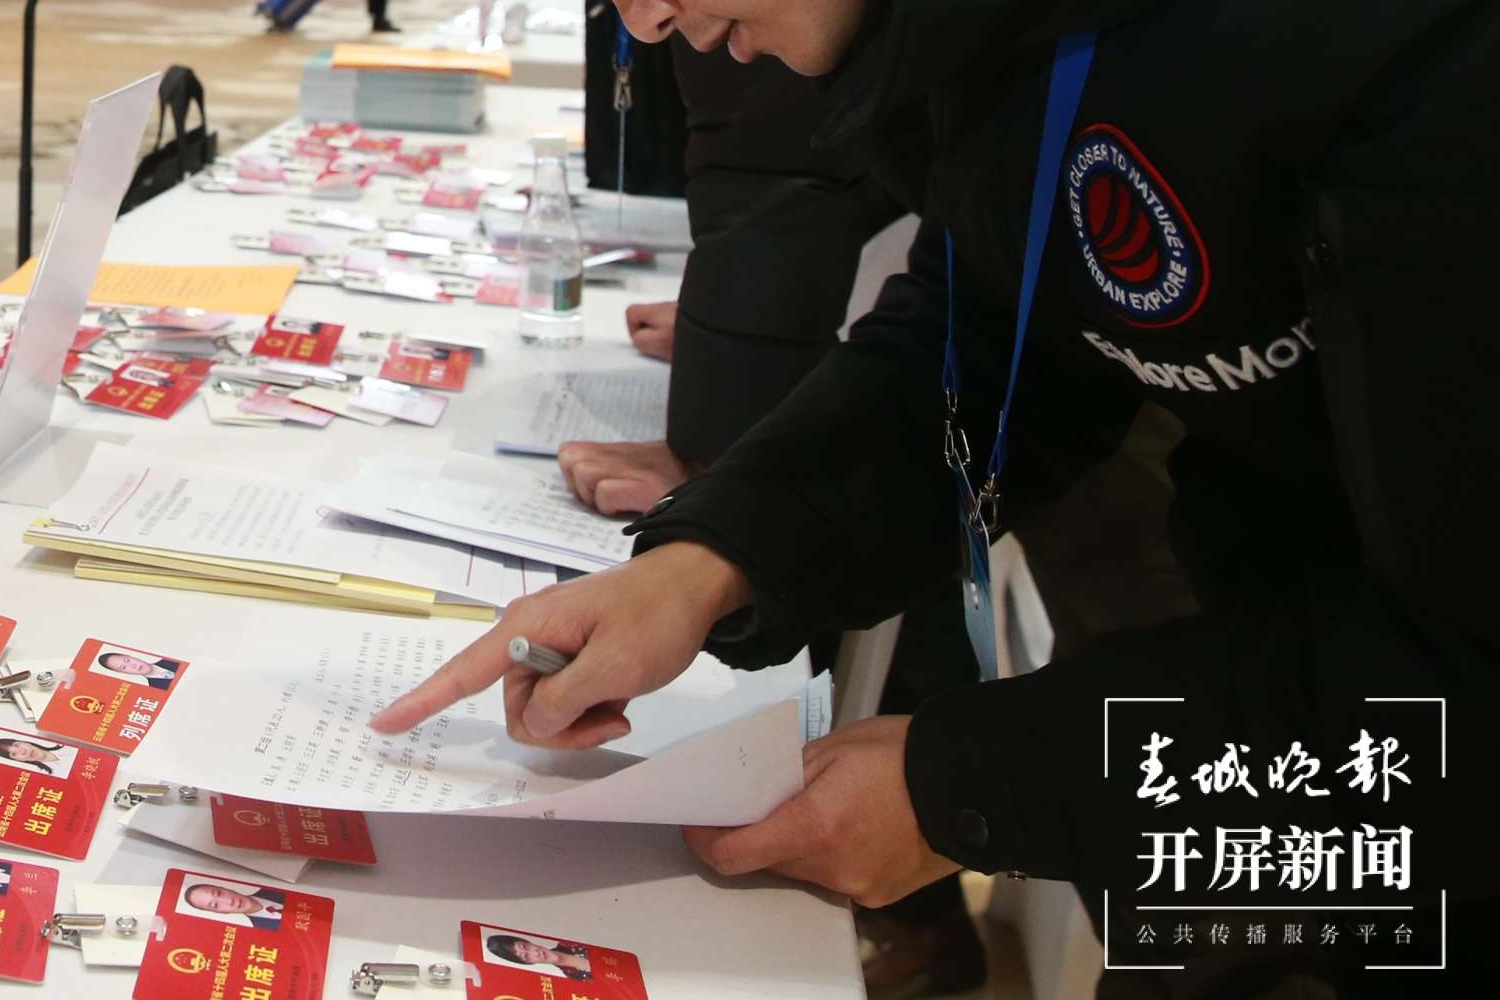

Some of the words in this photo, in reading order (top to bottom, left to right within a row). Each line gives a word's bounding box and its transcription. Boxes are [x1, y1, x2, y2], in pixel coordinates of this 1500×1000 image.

[1070, 143, 1109, 188] CLOSER
[1109, 145, 1126, 171] TO
[1069, 187, 1084, 228] GET
[1128, 167, 1185, 249] NATURE
[1083, 243, 1126, 305] URBAN
[1129, 259, 1188, 311] EXPLORE
[119, 696, 159, 742] 列席证
[24, 785, 64, 836] 出席证
